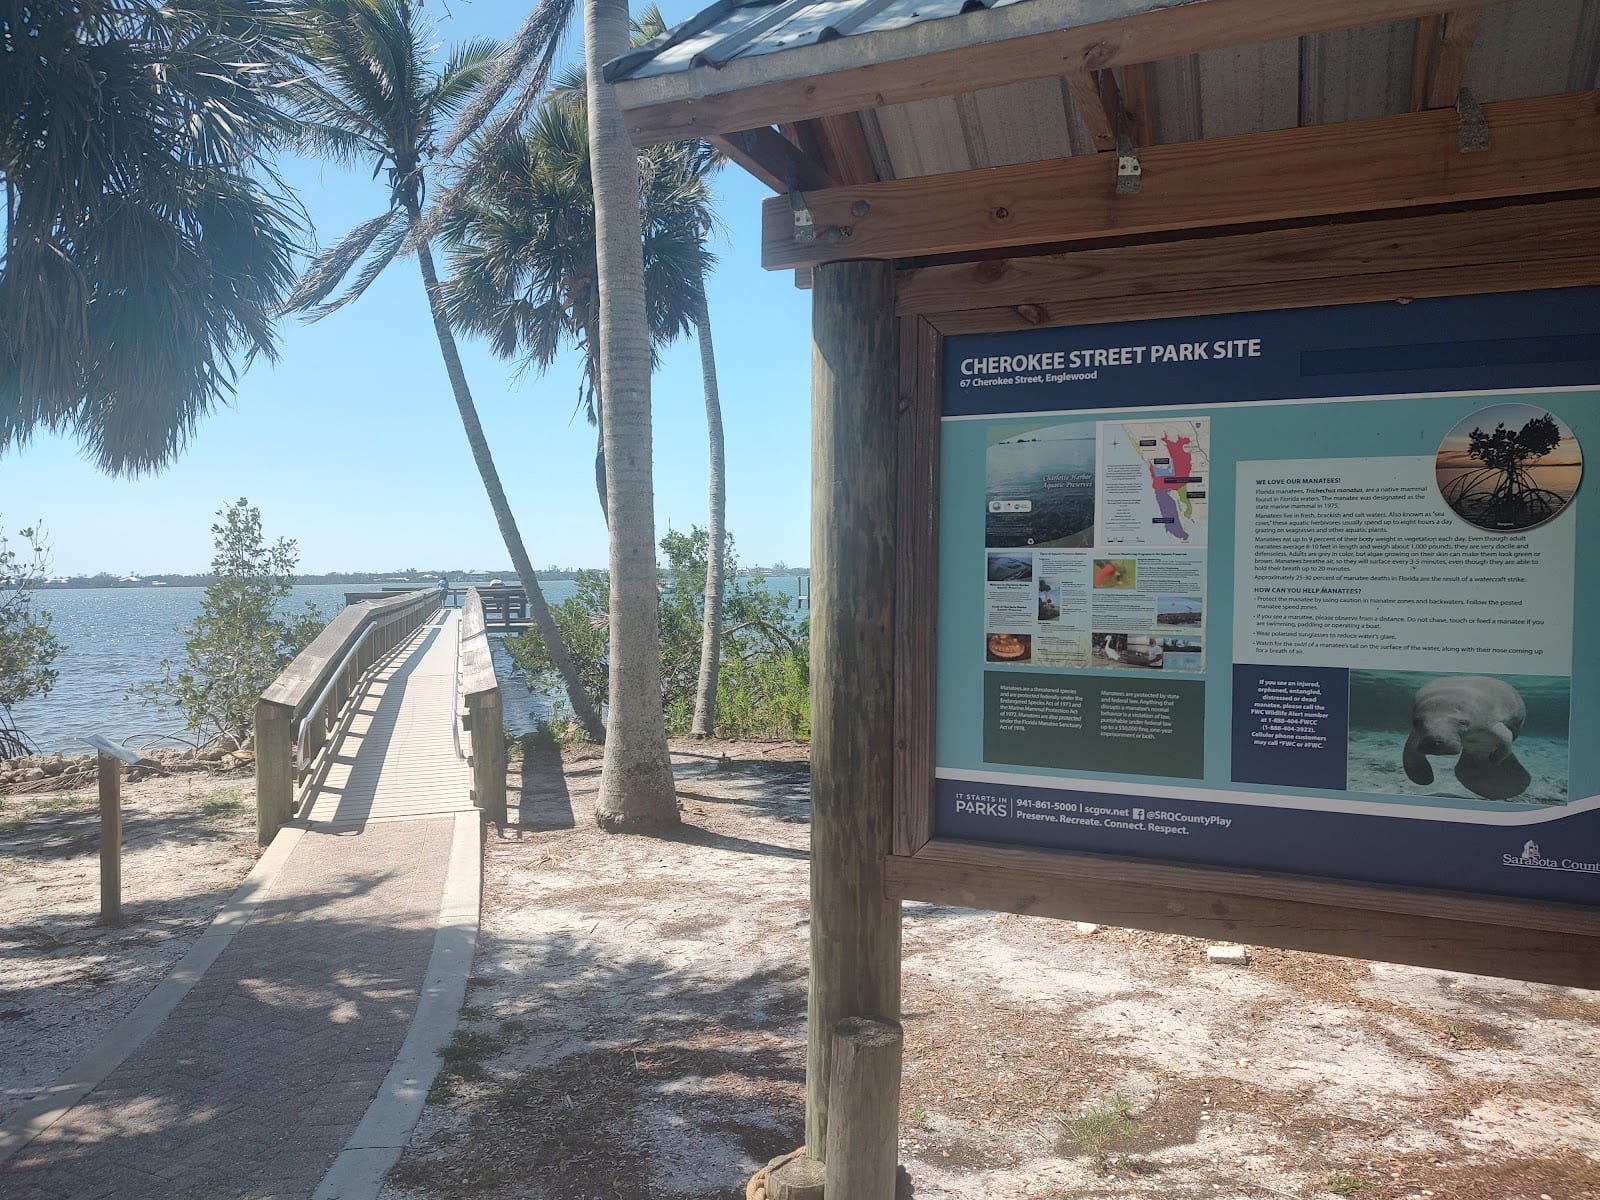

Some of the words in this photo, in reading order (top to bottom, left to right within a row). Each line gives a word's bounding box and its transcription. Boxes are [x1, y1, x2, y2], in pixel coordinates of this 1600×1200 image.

[960, 352, 1064, 375] CHEROKEE
[1069, 347, 1146, 368] STREET
[1151, 342, 1209, 362] PARK
[1214, 339, 1261, 359] SITE
[960, 379, 970, 388] 67
[972, 376, 1013, 387] Cherokee
[1015, 375, 1044, 384] Street,
[1046, 370, 1097, 383] Englewood
[1042, 473, 1070, 481] Charlotte
[1071, 472, 1092, 481] Harbor
[1042, 481, 1066, 490] Aquatic
[1066, 480, 1093, 488] Preserves
[1282, 702, 1302, 711] please
[1275, 732, 1294, 741] phone
[966, 794, 995, 802] STARTS
[956, 800, 1007, 817] PARKS
[1017, 799, 1077, 812] 941-861-5000
[1085, 806, 1129, 816] scgov.net
[1147, 811, 1232, 828] @SRQCountyPlay
[1017, 811, 1058, 822] Preserve.
[1060, 815, 1102, 826] Recreate.
[1104, 819, 1146, 830] Connect.
[1148, 823, 1189, 834] Respect.
[1503, 854, 1558, 868] Sarasota
